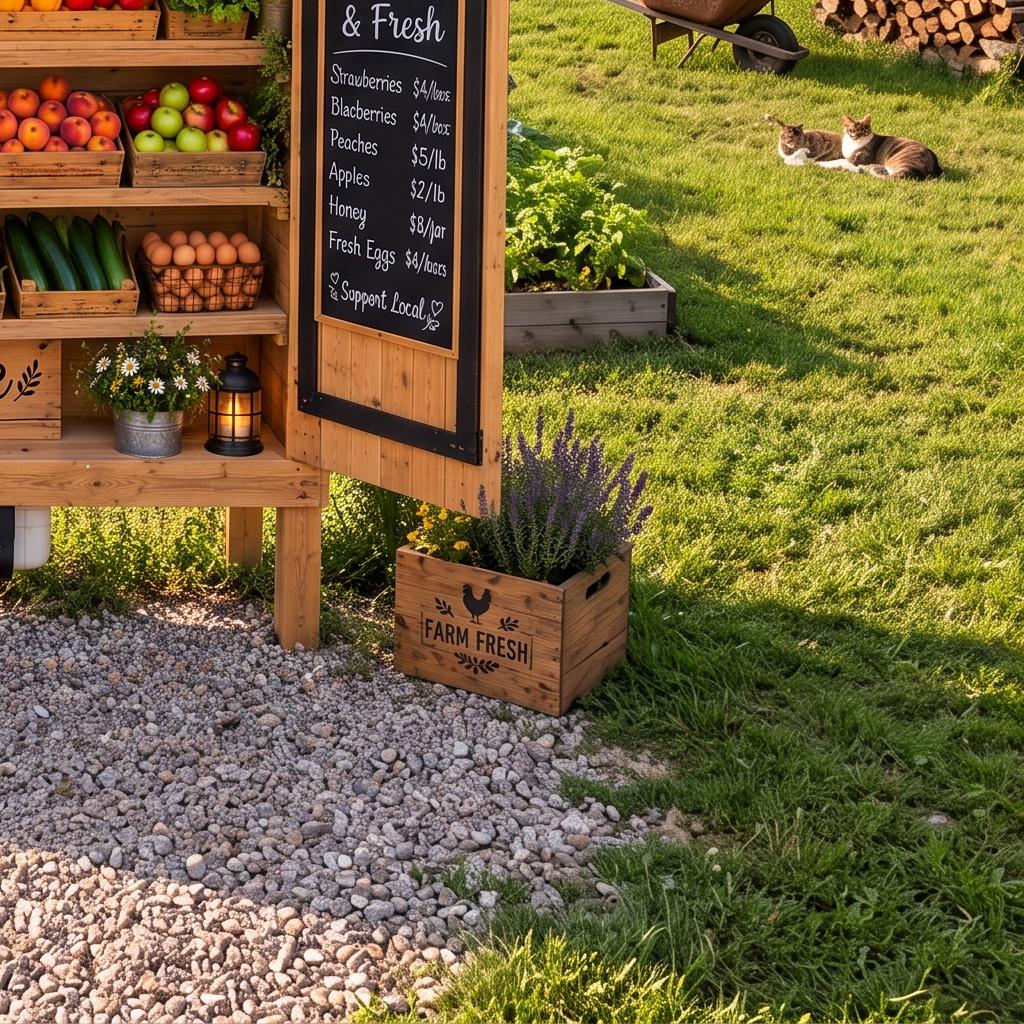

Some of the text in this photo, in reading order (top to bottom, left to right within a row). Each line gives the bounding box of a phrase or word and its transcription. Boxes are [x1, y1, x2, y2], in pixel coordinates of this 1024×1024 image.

[342, 3, 446, 43] & Fresh
[330, 96, 397, 126] Blacberries
[330, 128, 447, 171] Peaches $5/lb
[328, 161, 446, 204] Apples $2/lb
[328, 193, 367, 231] Honey
[328, 229, 361, 257] Fresh
[366, 239, 396, 272] Eggs
[390, 291, 426, 321] Local
[424, 618, 528, 665] FARM FRESH
